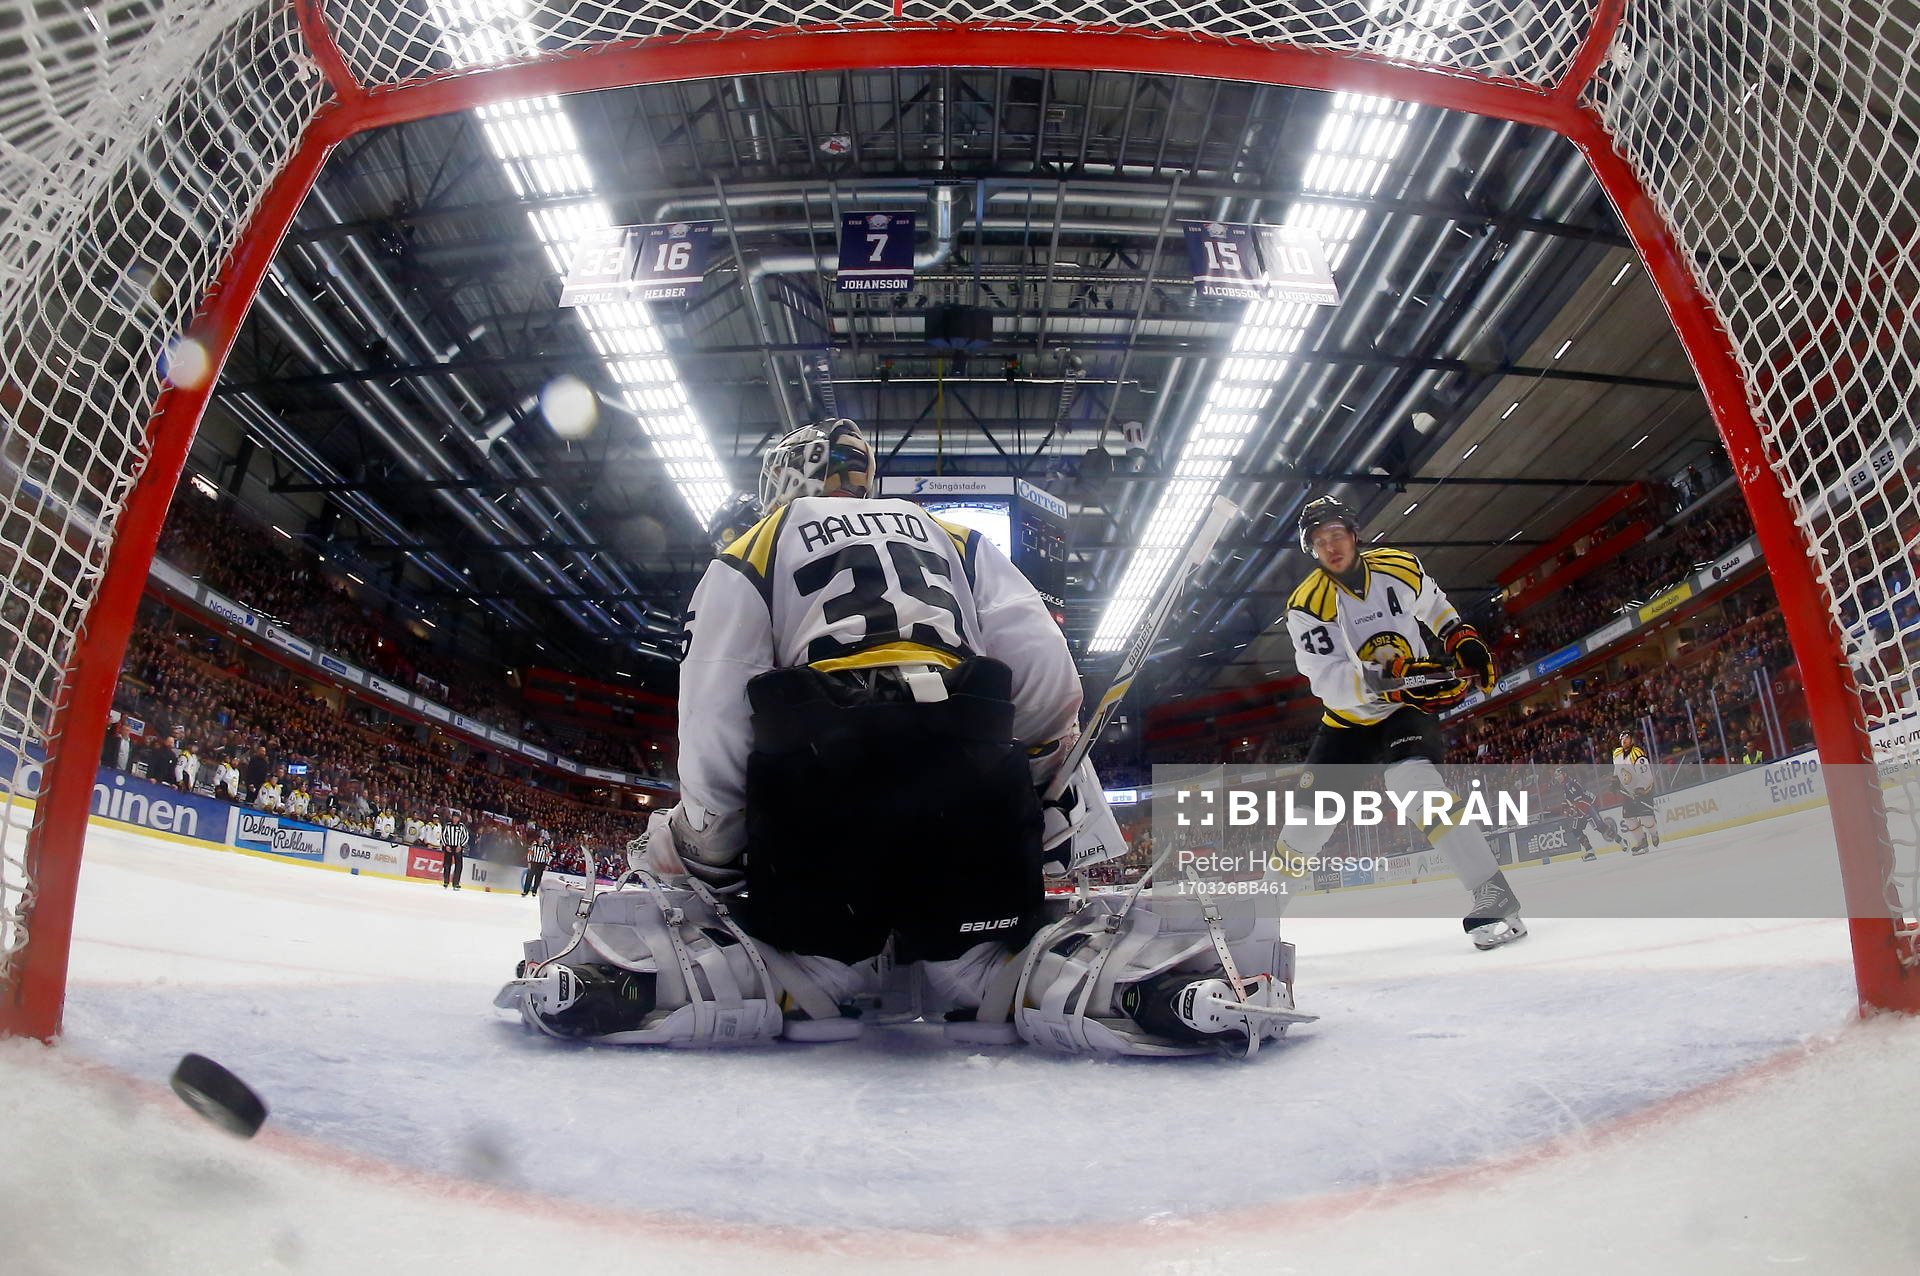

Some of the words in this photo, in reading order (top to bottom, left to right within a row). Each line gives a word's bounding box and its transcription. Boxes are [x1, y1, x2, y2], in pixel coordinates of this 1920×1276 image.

[653, 242, 691, 271] 16
[865, 234, 888, 261] 7
[1204, 241, 1242, 271] 15
[1277, 246, 1314, 274] 10
[644, 287, 686, 299] HELBER
[842, 279, 908, 290] JOHANSSON
[1203, 286, 1261, 299] JACOBSSON
[1872, 450, 1895, 471] SEB
[929, 481, 986, 491] Stångåstaden
[1019, 483, 1066, 516] Corren
[798, 511, 929, 552] RAUTIO
[1721, 557, 1740, 573] SAAB
[793, 541, 966, 659] 35
[1387, 586, 1403, 616] A
[1355, 614, 1377, 625] unicef
[1301, 625, 1335, 656] 33
[1764, 758, 1819, 786] ActiPro
[1770, 777, 1815, 803] Event
[1666, 798, 1719, 823] ARENA
[242, 814, 277, 839] Dekor
[272, 829, 314, 853] Reklam
[1076, 844, 1106, 859] UER
[351, 848, 371, 860] SAAB
[374, 853, 398, 864] ARENA
[413, 857, 444, 873] CC
[960, 916, 1019, 932] BAUER
